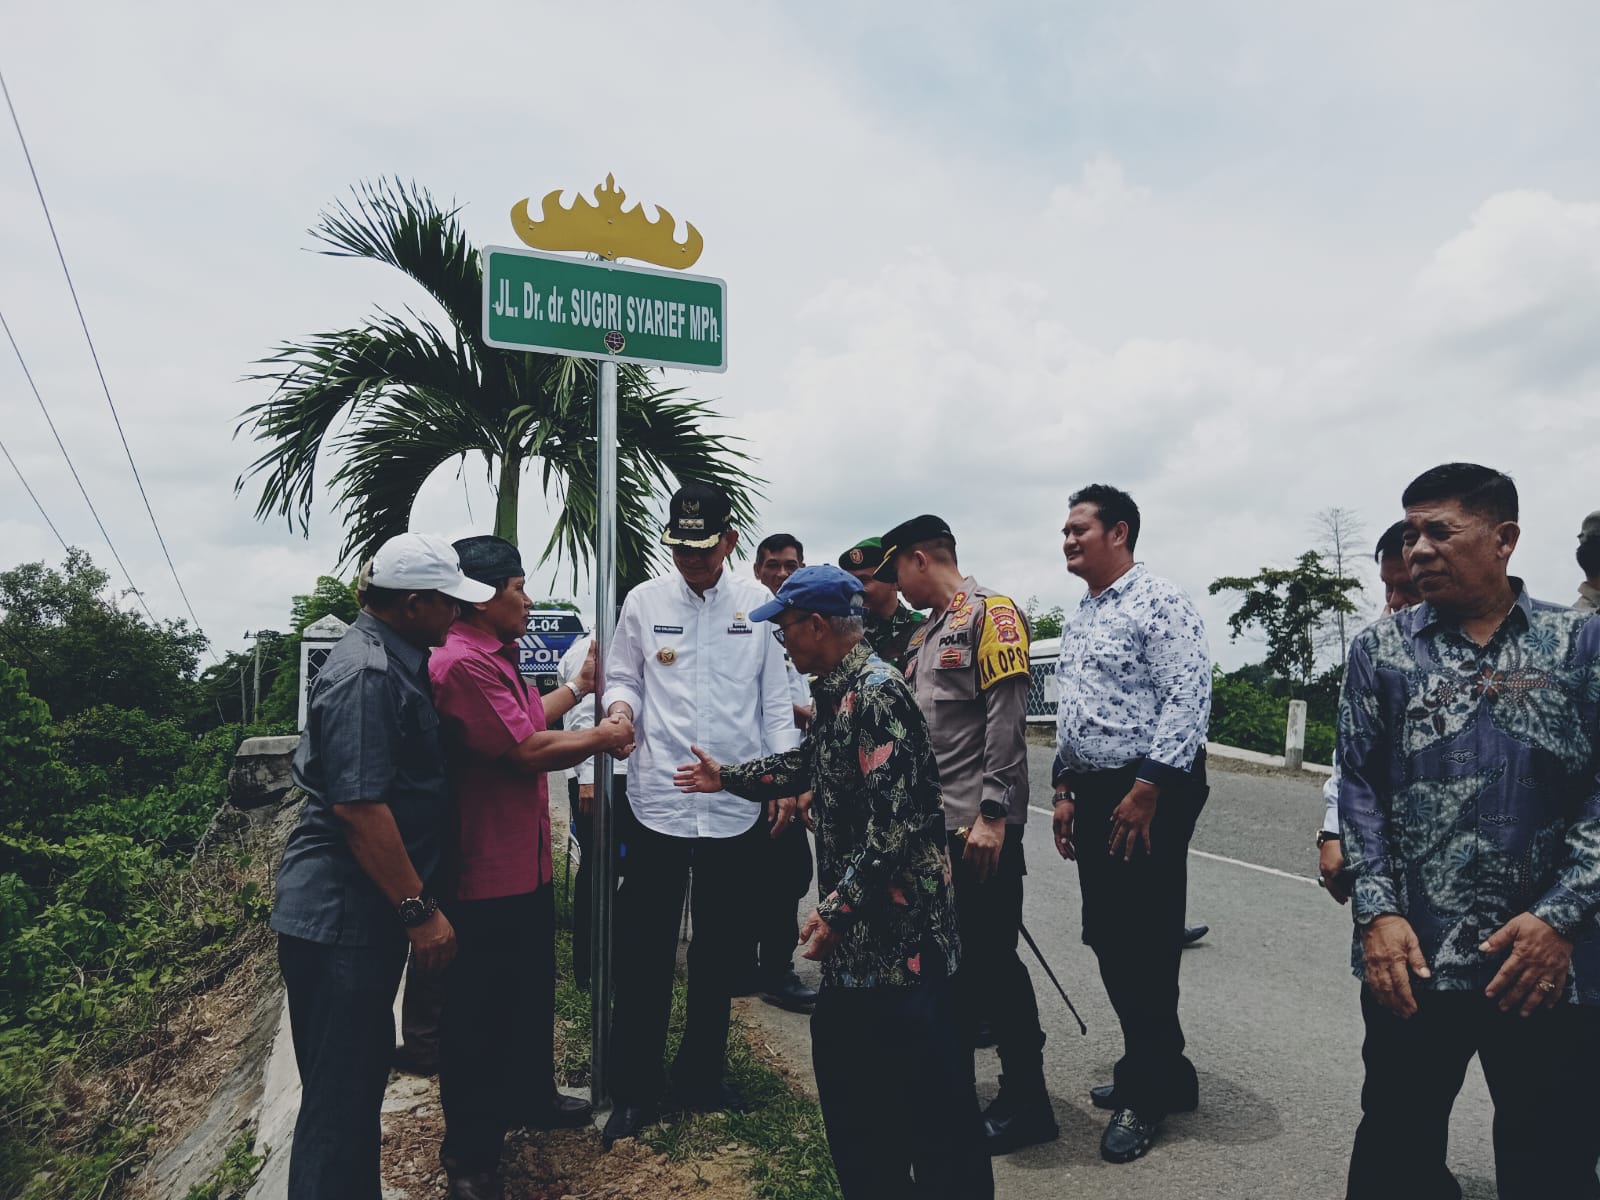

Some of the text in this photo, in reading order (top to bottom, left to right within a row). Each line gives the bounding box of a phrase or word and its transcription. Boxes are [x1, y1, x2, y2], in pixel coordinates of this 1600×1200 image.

[494, 278, 518, 318] JL.
[523, 281, 543, 321] Dr.
[548, 286, 566, 324] dr.
[570, 288, 622, 331] SUGIRI
[626, 296, 685, 339] SYARIEF
[939, 632, 968, 647] POLRI
[519, 649, 562, 664] POL
